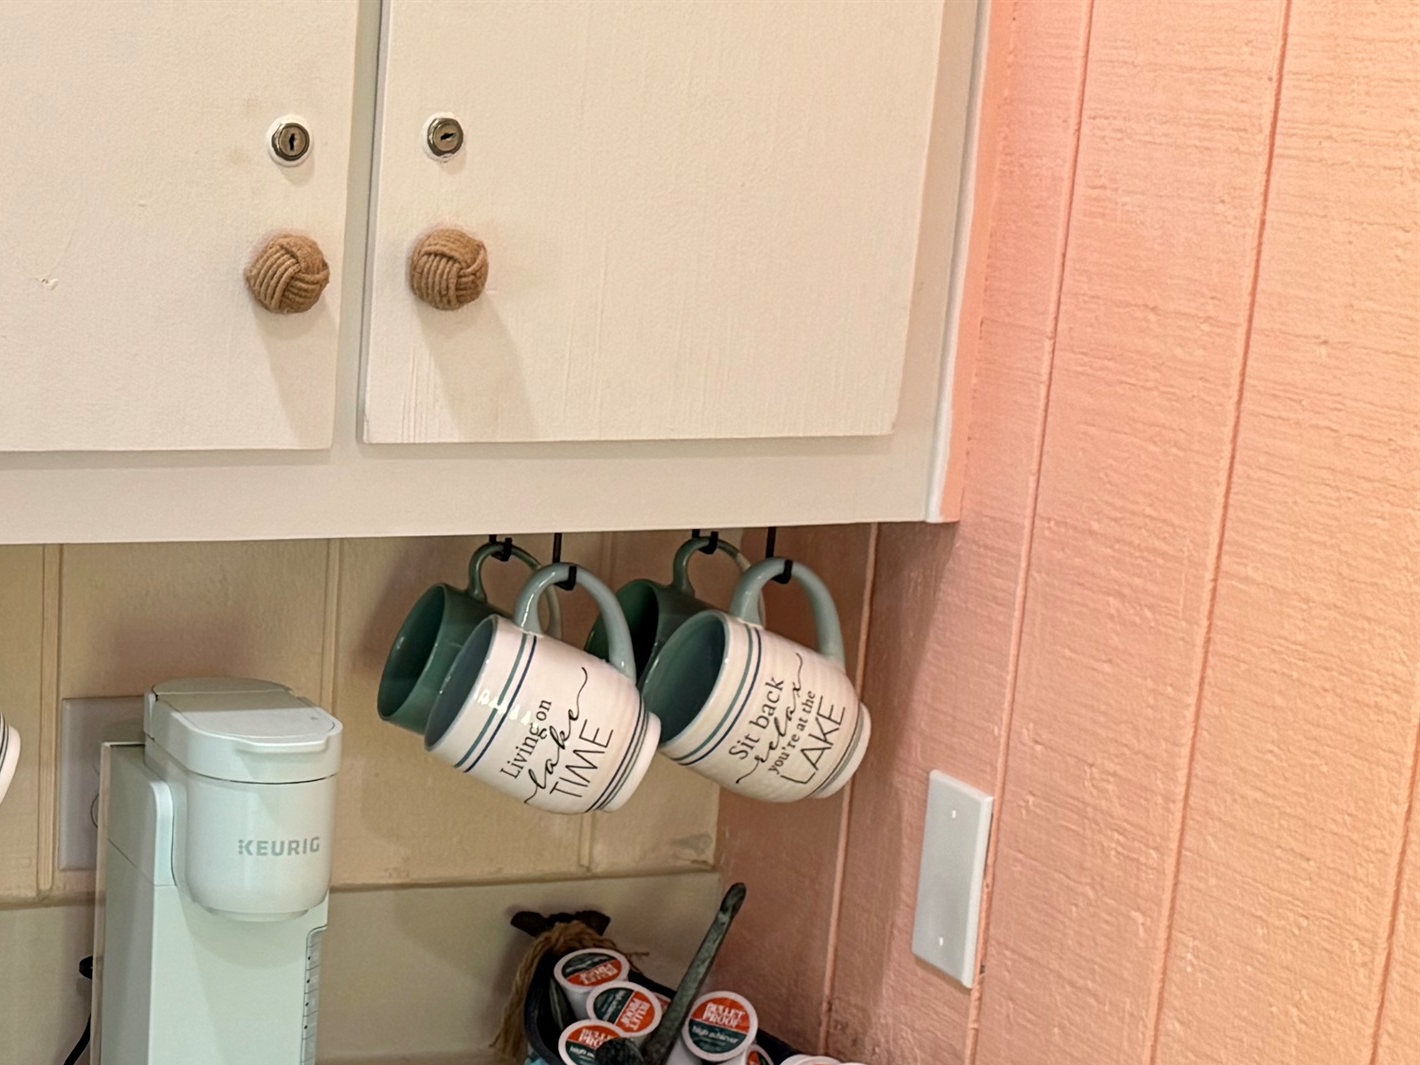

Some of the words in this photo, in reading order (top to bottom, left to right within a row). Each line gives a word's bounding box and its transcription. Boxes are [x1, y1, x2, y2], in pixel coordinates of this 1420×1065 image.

[500, 722, 548, 779] Living
[536, 699, 552, 721] on
[549, 719, 614, 798] TIME
[728, 733, 760, 760] Sit
[749, 676, 785, 729] back
[736, 652, 803, 784] relax
[768, 733, 800, 775] you're
[796, 716, 808, 731] at
[802, 690, 816, 714] the
[781, 695, 846, 785] LAKE
[237, 836, 321, 857] KEURIG
